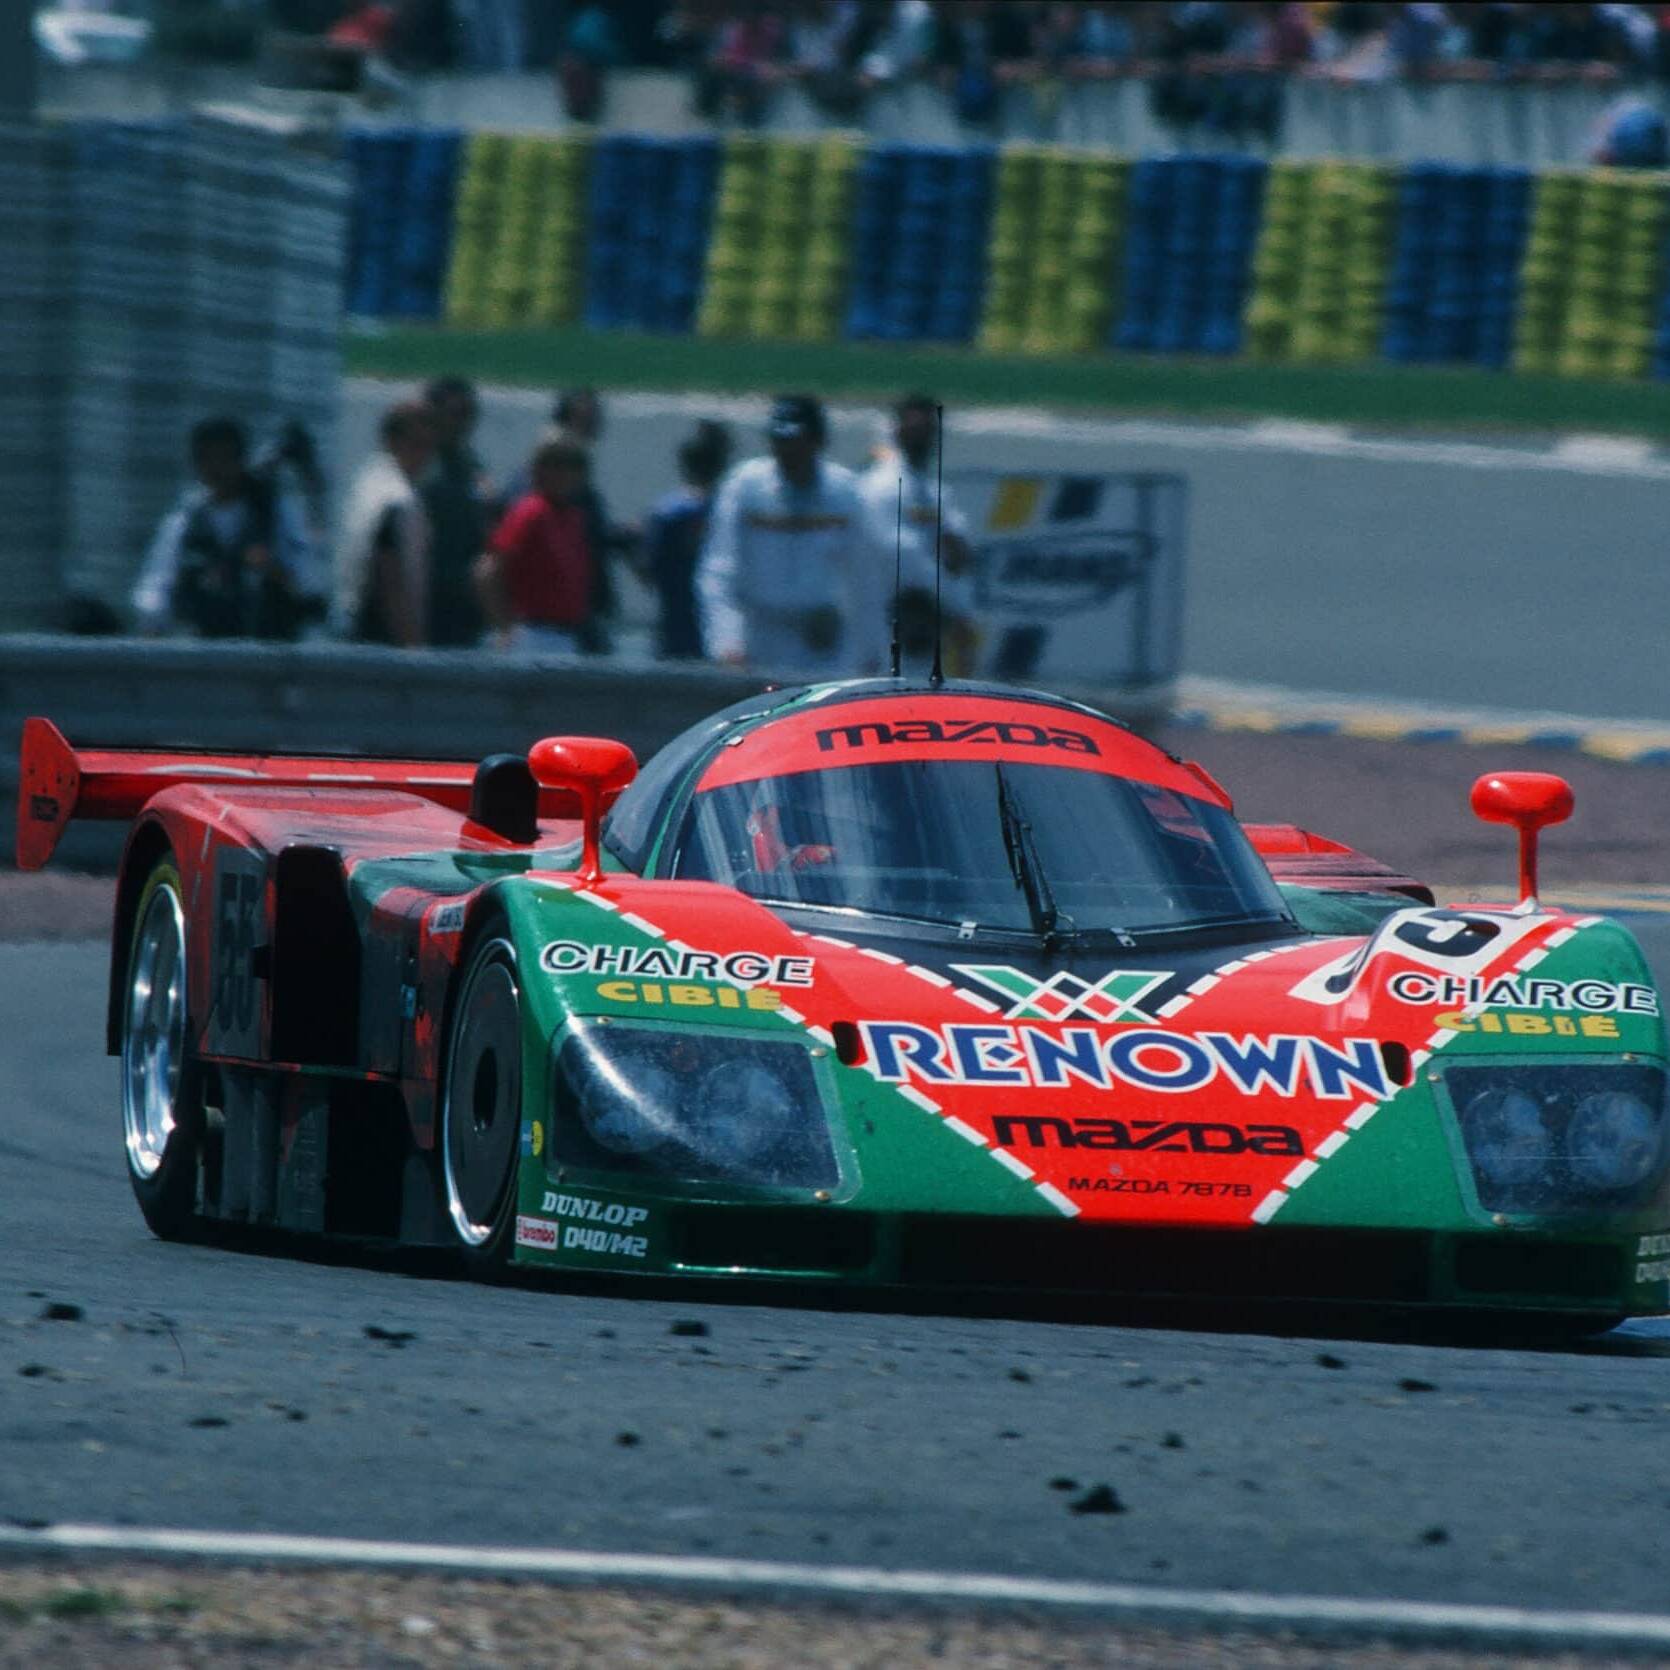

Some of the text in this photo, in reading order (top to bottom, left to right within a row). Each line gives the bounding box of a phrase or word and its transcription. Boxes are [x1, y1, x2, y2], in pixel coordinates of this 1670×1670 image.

[815, 720, 1102, 757] mazda
[541, 941, 814, 988] CHARGE
[1387, 971, 1660, 1016] CHARGE
[860, 1021, 1393, 1100] RENOWN
[992, 1115, 1304, 1156] mazda
[1068, 1177, 1170, 1194] MAZDA
[541, 1191, 648, 1227] DUNLOP
